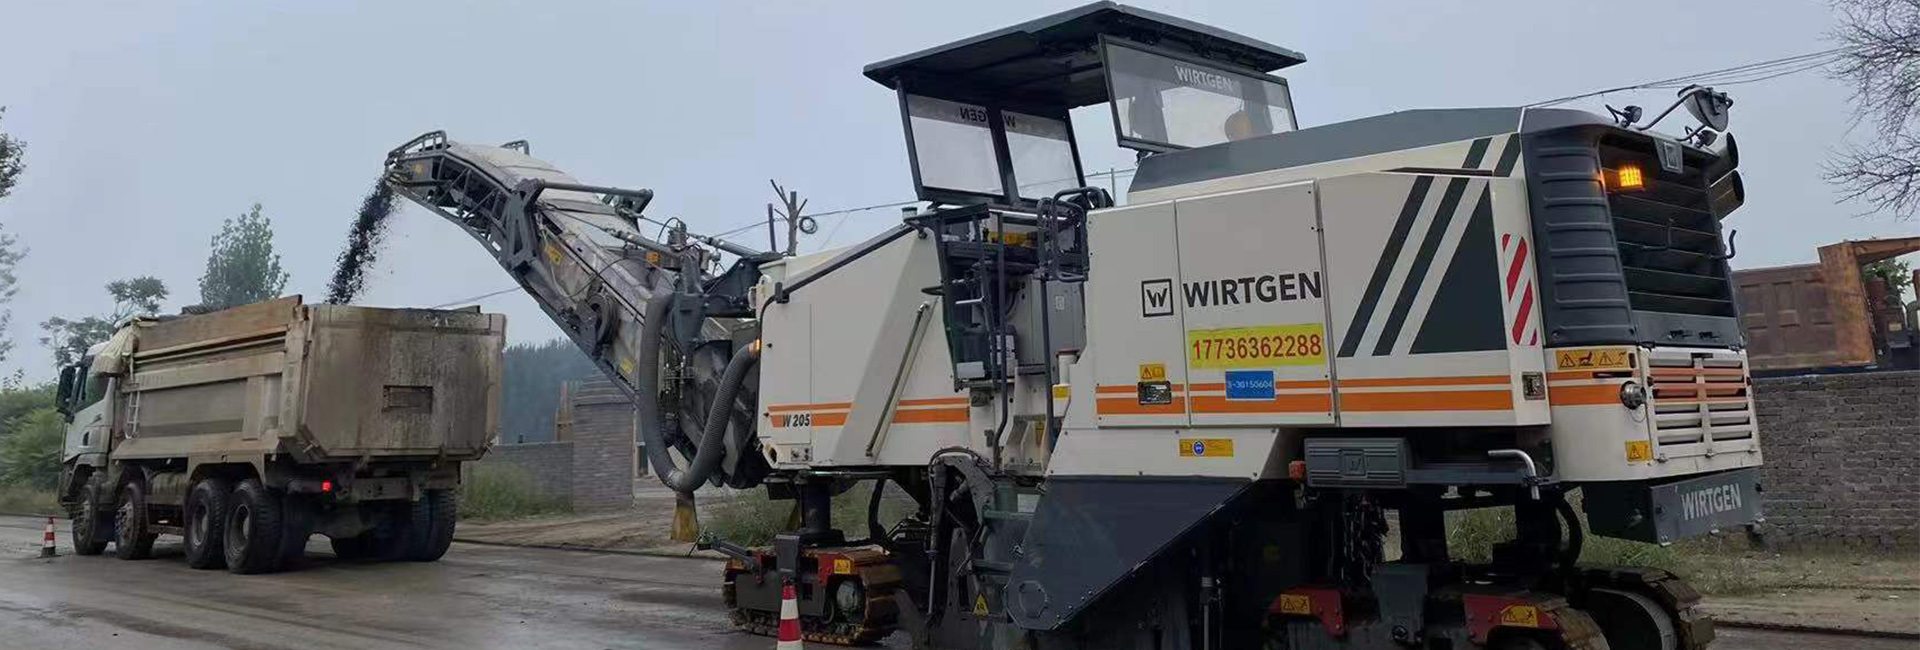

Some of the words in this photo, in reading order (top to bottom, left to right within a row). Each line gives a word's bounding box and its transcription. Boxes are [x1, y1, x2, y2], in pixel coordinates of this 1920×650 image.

[1174, 65, 1234, 92] WIRTGEN
[1183, 271, 1322, 308] WIRTGEN
[1193, 334, 1322, 360] 17736362288
[782, 413, 792, 428] W
[792, 413, 810, 428] 205
[1681, 483, 1742, 520] WIRTGEN
